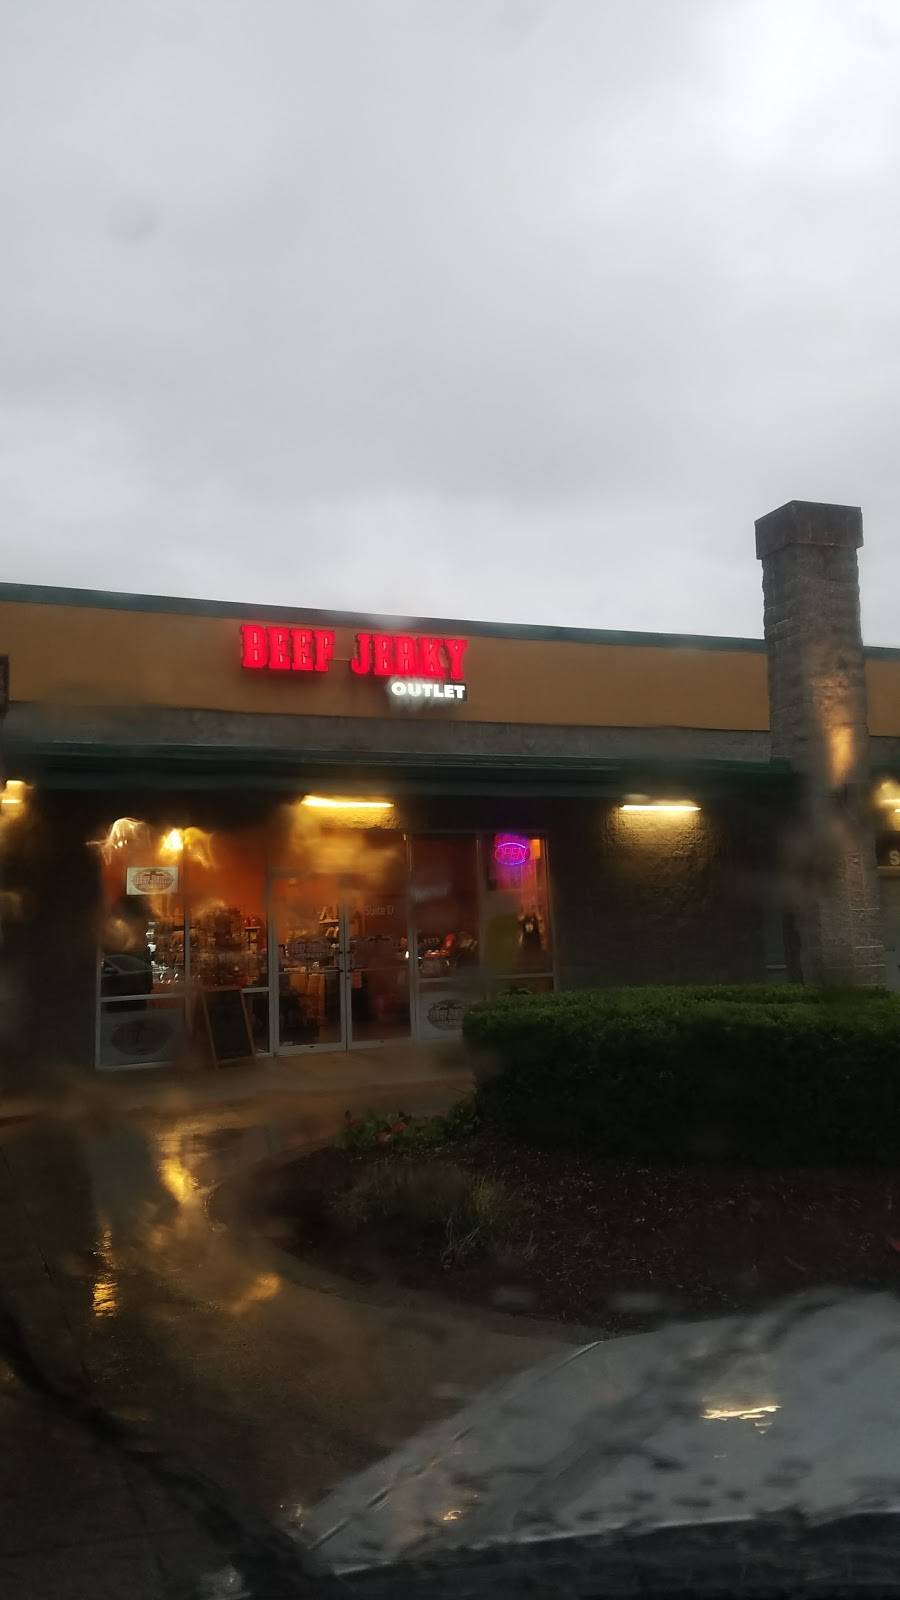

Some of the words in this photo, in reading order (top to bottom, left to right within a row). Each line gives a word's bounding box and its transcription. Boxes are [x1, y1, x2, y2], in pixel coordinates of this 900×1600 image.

[242, 624, 335, 672] BEEF
[352, 632, 468, 679] JERKY
[391, 681, 466, 699] OUTLET
